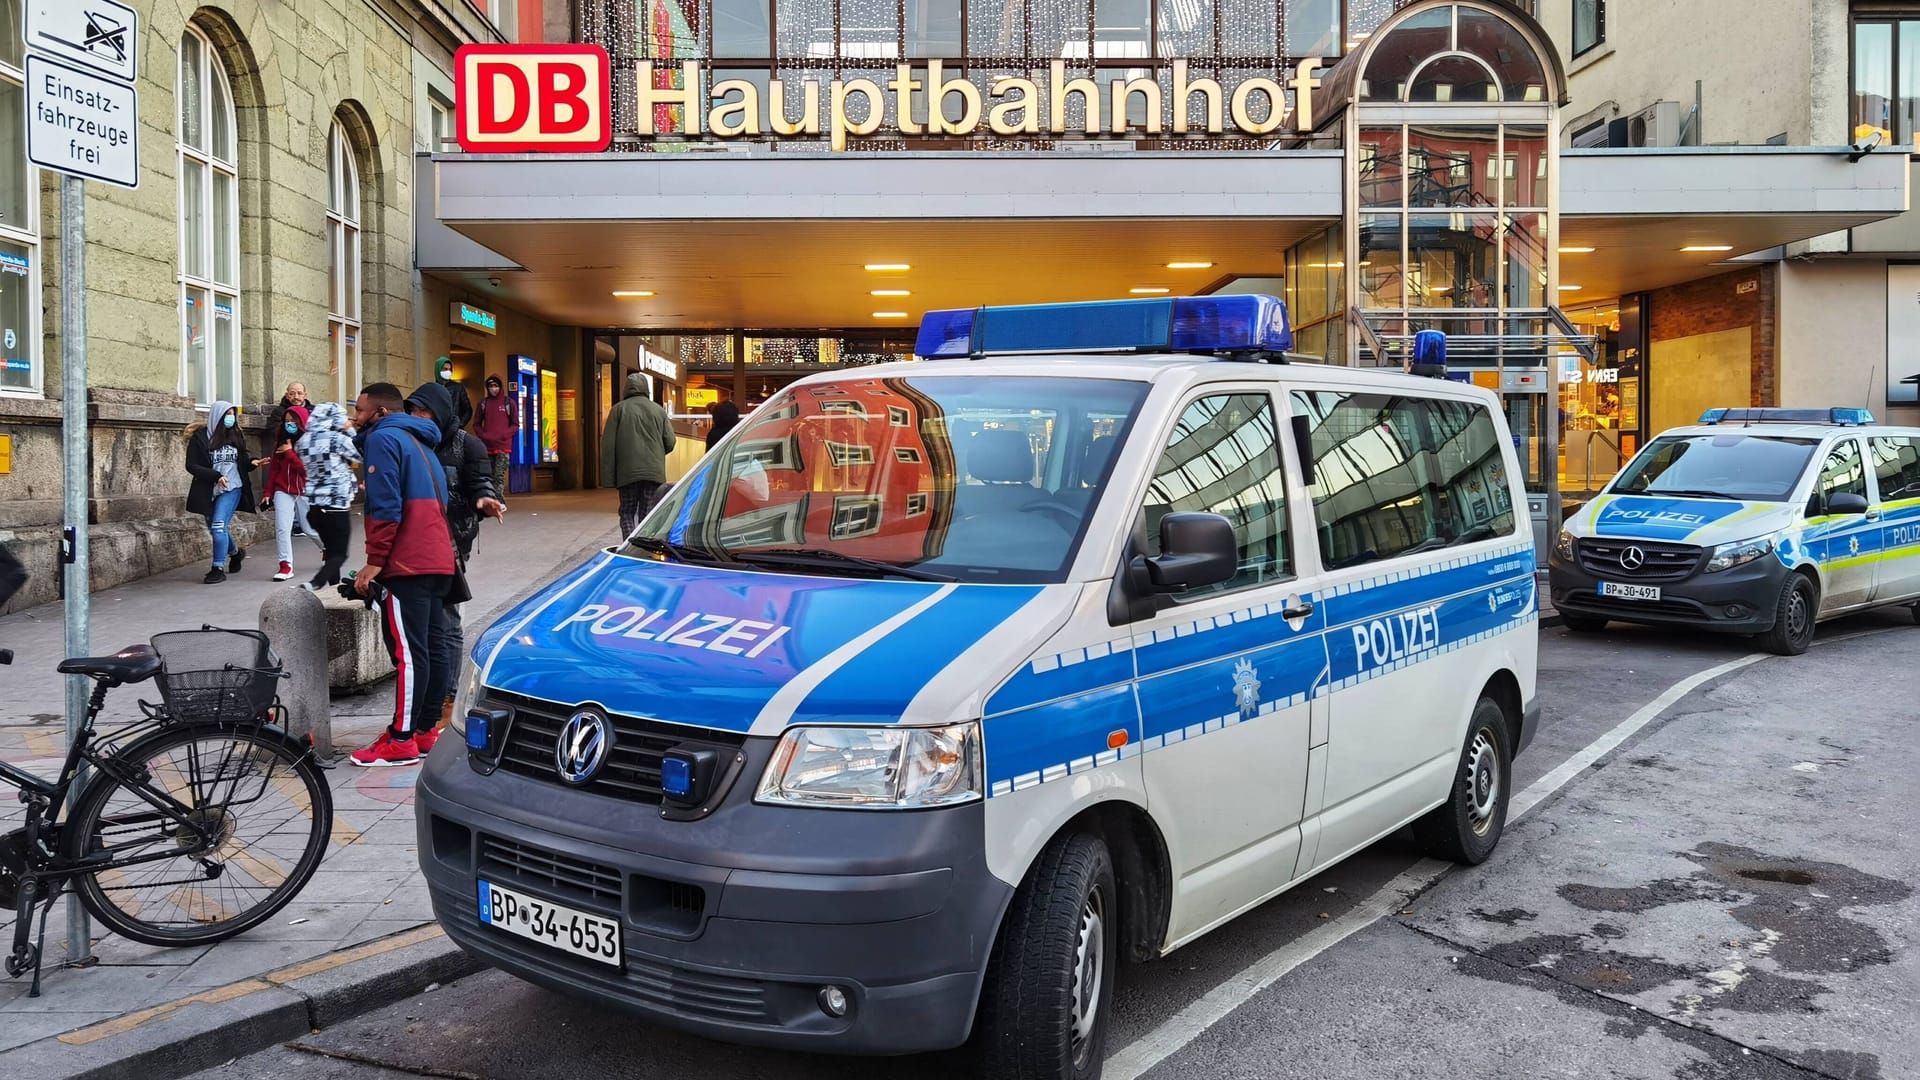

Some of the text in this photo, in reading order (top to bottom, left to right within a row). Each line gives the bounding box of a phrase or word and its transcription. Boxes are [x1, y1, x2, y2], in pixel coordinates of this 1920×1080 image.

[45, 74, 120, 113] Einsatz-
[477, 62, 591, 135] DB
[635, 56, 1323, 152] Hauptbahnhof
[37, 101, 128, 147] fahrzeuge
[70, 139, 100, 165] frei
[461, 304, 496, 329] Sparda-Bank
[1605, 510, 1706, 524] POLIZEI
[1605, 583, 1657, 599] BP 30-491
[552, 604, 792, 659] POLIZEI
[1351, 605, 1440, 672] POLIZEI
[490, 888, 616, 958] BP 34-653
